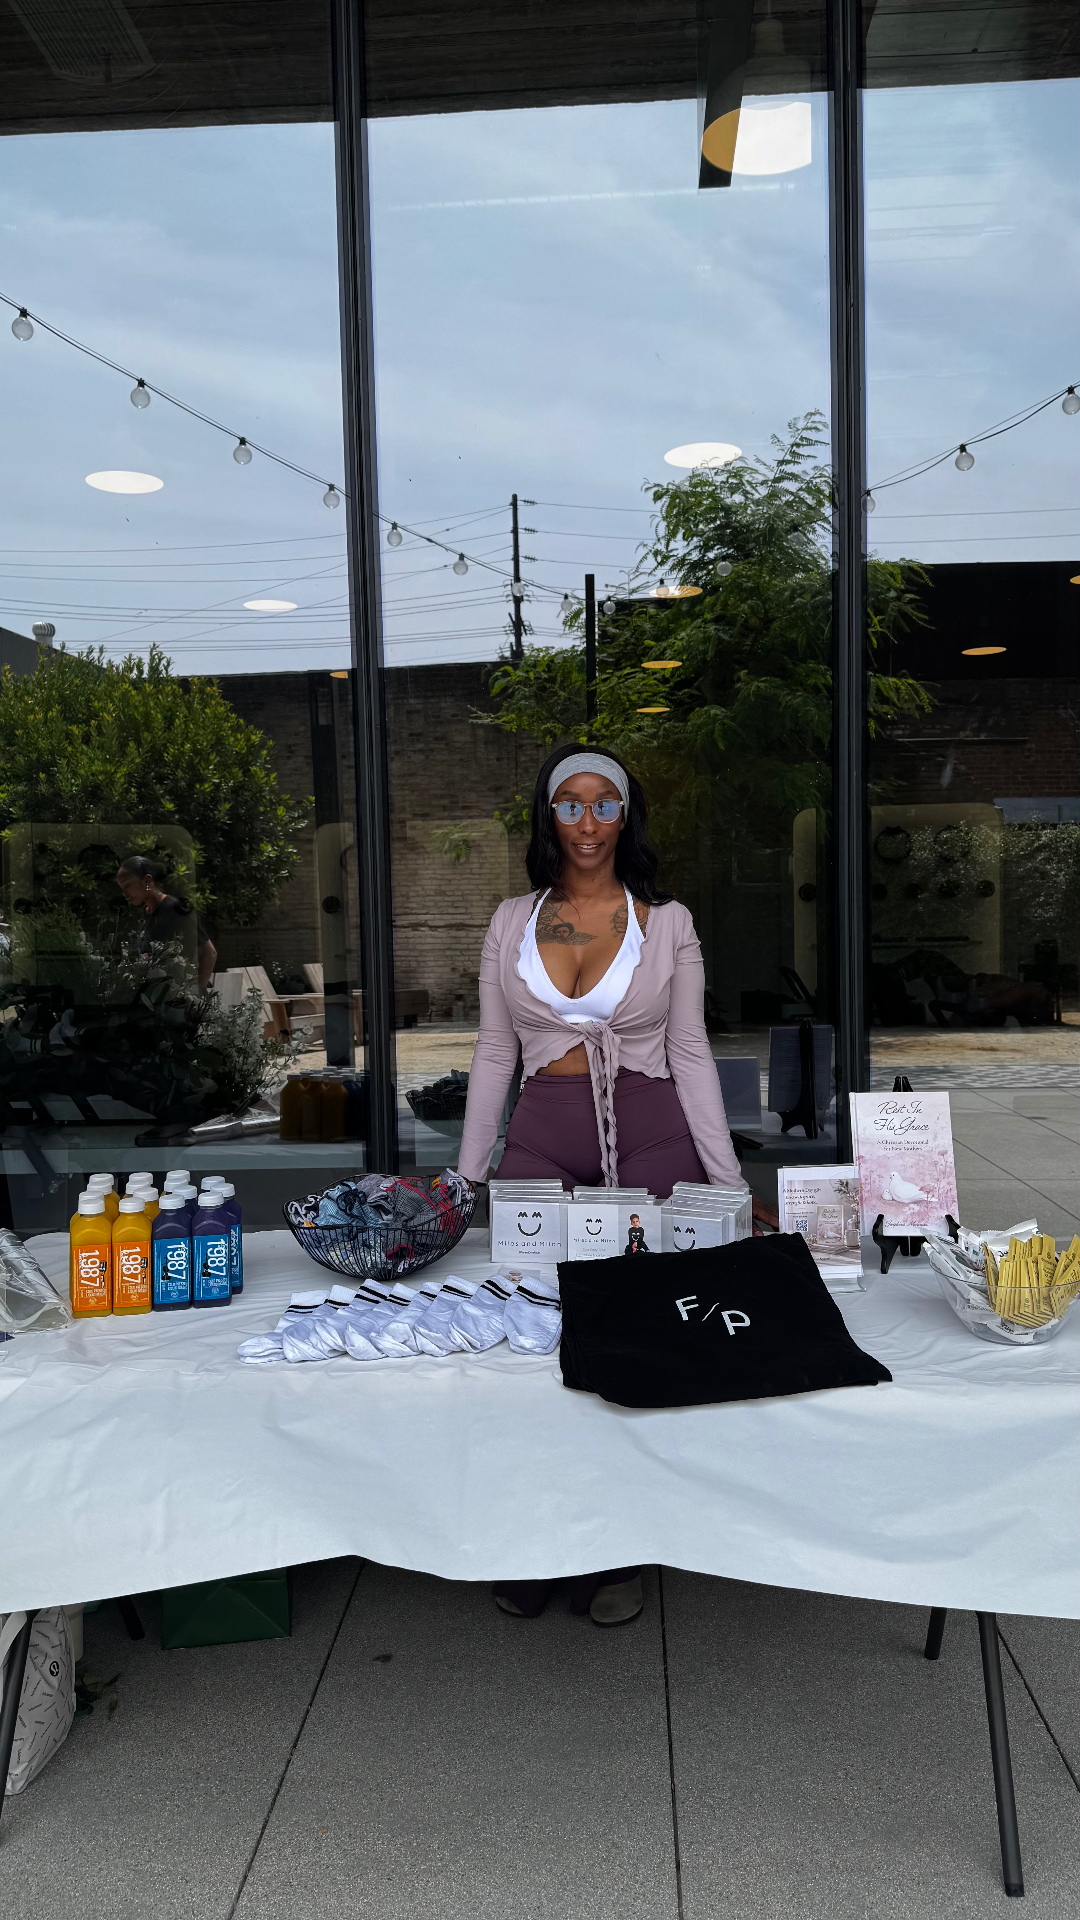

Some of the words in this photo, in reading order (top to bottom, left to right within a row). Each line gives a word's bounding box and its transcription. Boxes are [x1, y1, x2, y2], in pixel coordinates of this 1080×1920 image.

[877, 1100, 907, 1114] Rest
[906, 1100, 923, 1114] In
[873, 1117, 896, 1131] His
[893, 1116, 930, 1136] Grace
[81, 1250, 100, 1287] 1987
[122, 1246, 141, 1283] 1987
[166, 1241, 187, 1280] 1987
[206, 1238, 227, 1276] 1987
